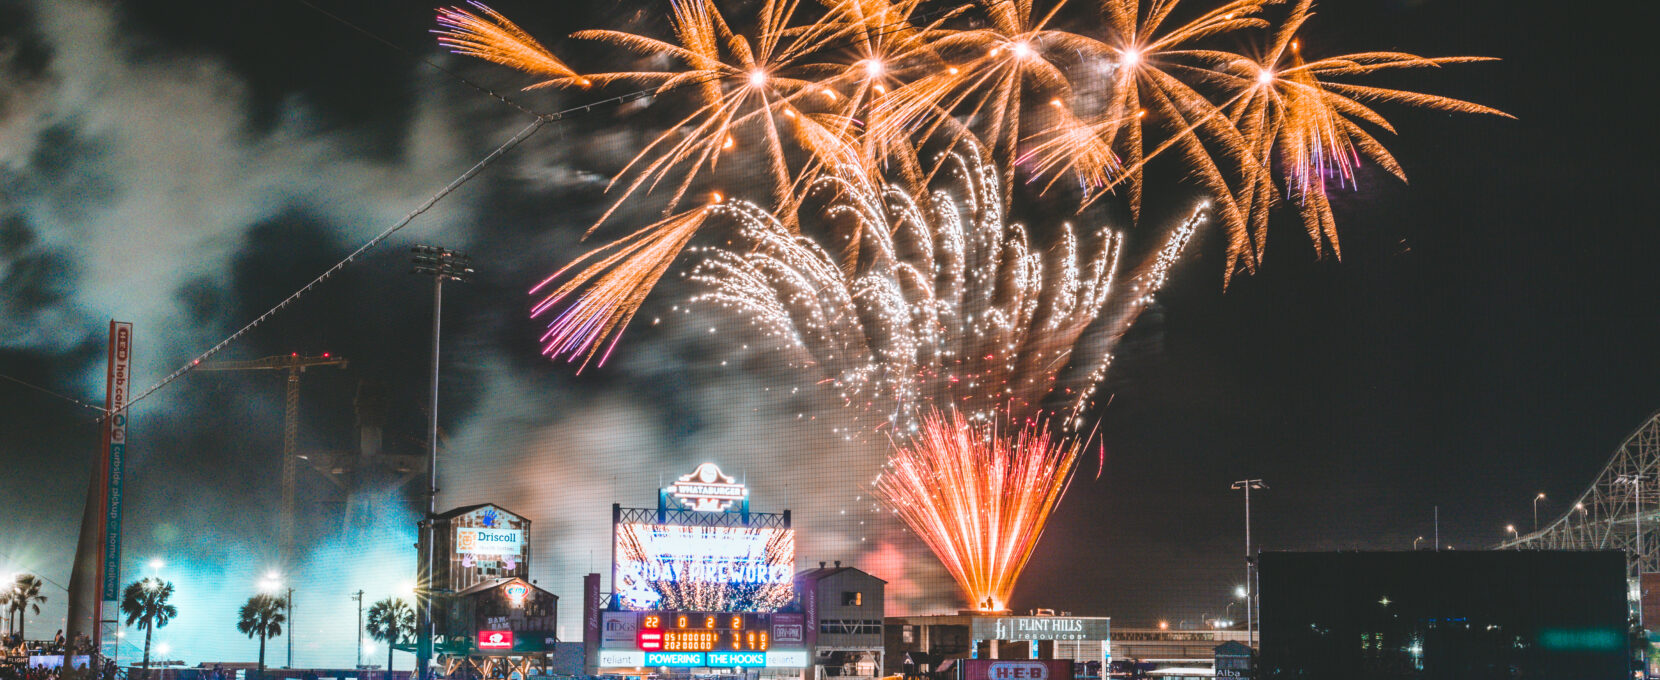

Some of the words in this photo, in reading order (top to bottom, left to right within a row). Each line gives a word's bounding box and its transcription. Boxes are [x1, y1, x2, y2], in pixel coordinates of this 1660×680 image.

[113, 447, 121, 485] curbside
[678, 485, 741, 496] WHATABURGER
[111, 487, 120, 519] pickup
[478, 531, 516, 542] Driscoll
[109, 533, 117, 560] home
[689, 562, 791, 584] FIREWORKS
[106, 561, 116, 598] delivery
[645, 617, 659, 628] 22
[679, 617, 687, 628] 0
[706, 617, 714, 628] 2
[733, 617, 740, 628] 2
[1018, 619, 1050, 631] FLINT
[1052, 619, 1082, 632] HILLS
[602, 655, 632, 664] reliant
[649, 654, 700, 664] POWERING
[709, 654, 728, 664] THE
[730, 654, 763, 664] HOOKS
[1216, 669, 1241, 677] Alba
